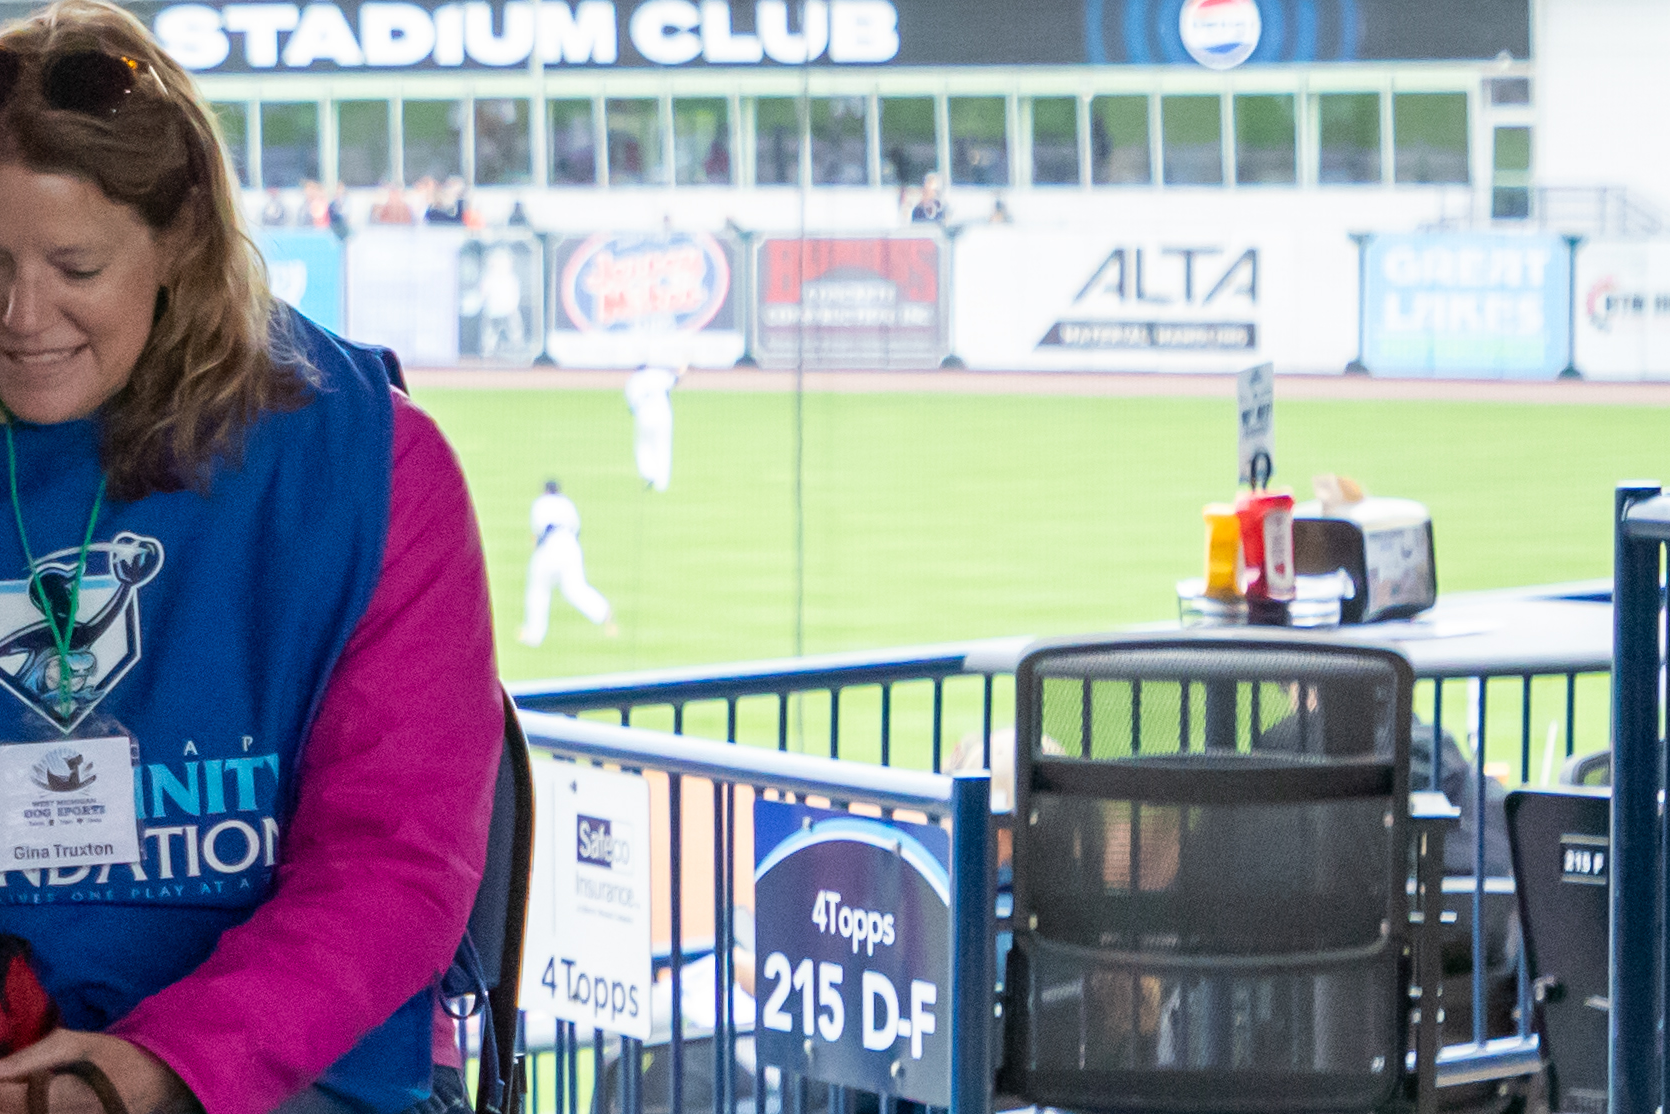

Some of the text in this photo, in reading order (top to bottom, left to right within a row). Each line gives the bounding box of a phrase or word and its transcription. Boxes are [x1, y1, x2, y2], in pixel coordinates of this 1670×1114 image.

[154, 0, 900, 68] STADIUM CLUB
[1071, 246, 1259, 305] ALTA
[1384, 246, 1551, 288] GREAT
[14, 843, 114, 861] Gina Truxton
[579, 819, 631, 866] Safeco
[811, 889, 896, 957] 4Topps
[541, 955, 640, 1022] 4Topps
[762, 951, 937, 1061] 215 D-F
